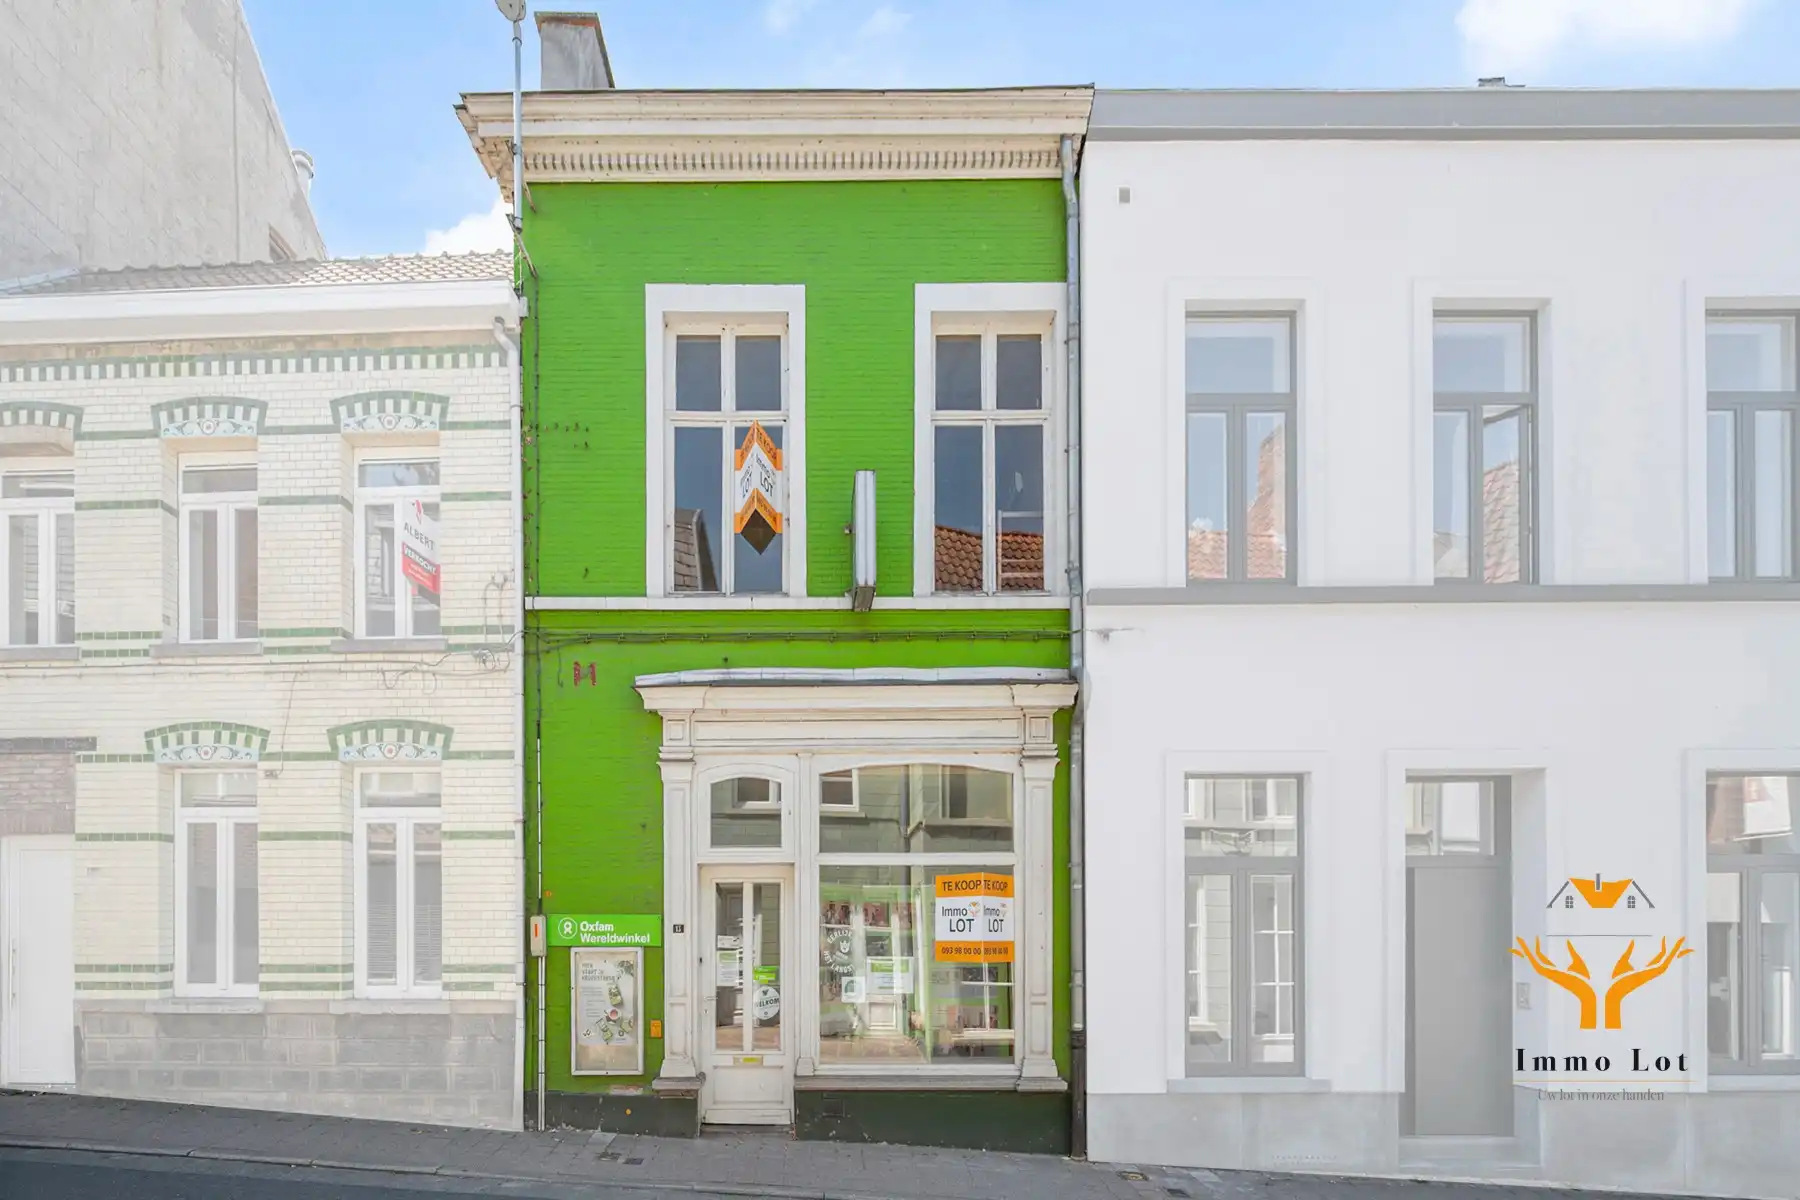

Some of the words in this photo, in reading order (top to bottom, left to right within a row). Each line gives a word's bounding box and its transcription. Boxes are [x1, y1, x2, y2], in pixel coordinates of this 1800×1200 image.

[760, 472, 773, 497] LOT
[404, 522, 434, 551] ALBERT
[942, 881, 952, 891] TE
[955, 880, 982, 891] KOOP
[984, 880, 991, 890] TE
[992, 880, 1008, 892] KOOP
[942, 906, 968, 917] Immo
[579, 921, 614, 932] Oxfam
[949, 918, 975, 933] LOT
[988, 918, 1004, 933] LOT
[580, 932, 650, 944] Wereldwinkel
